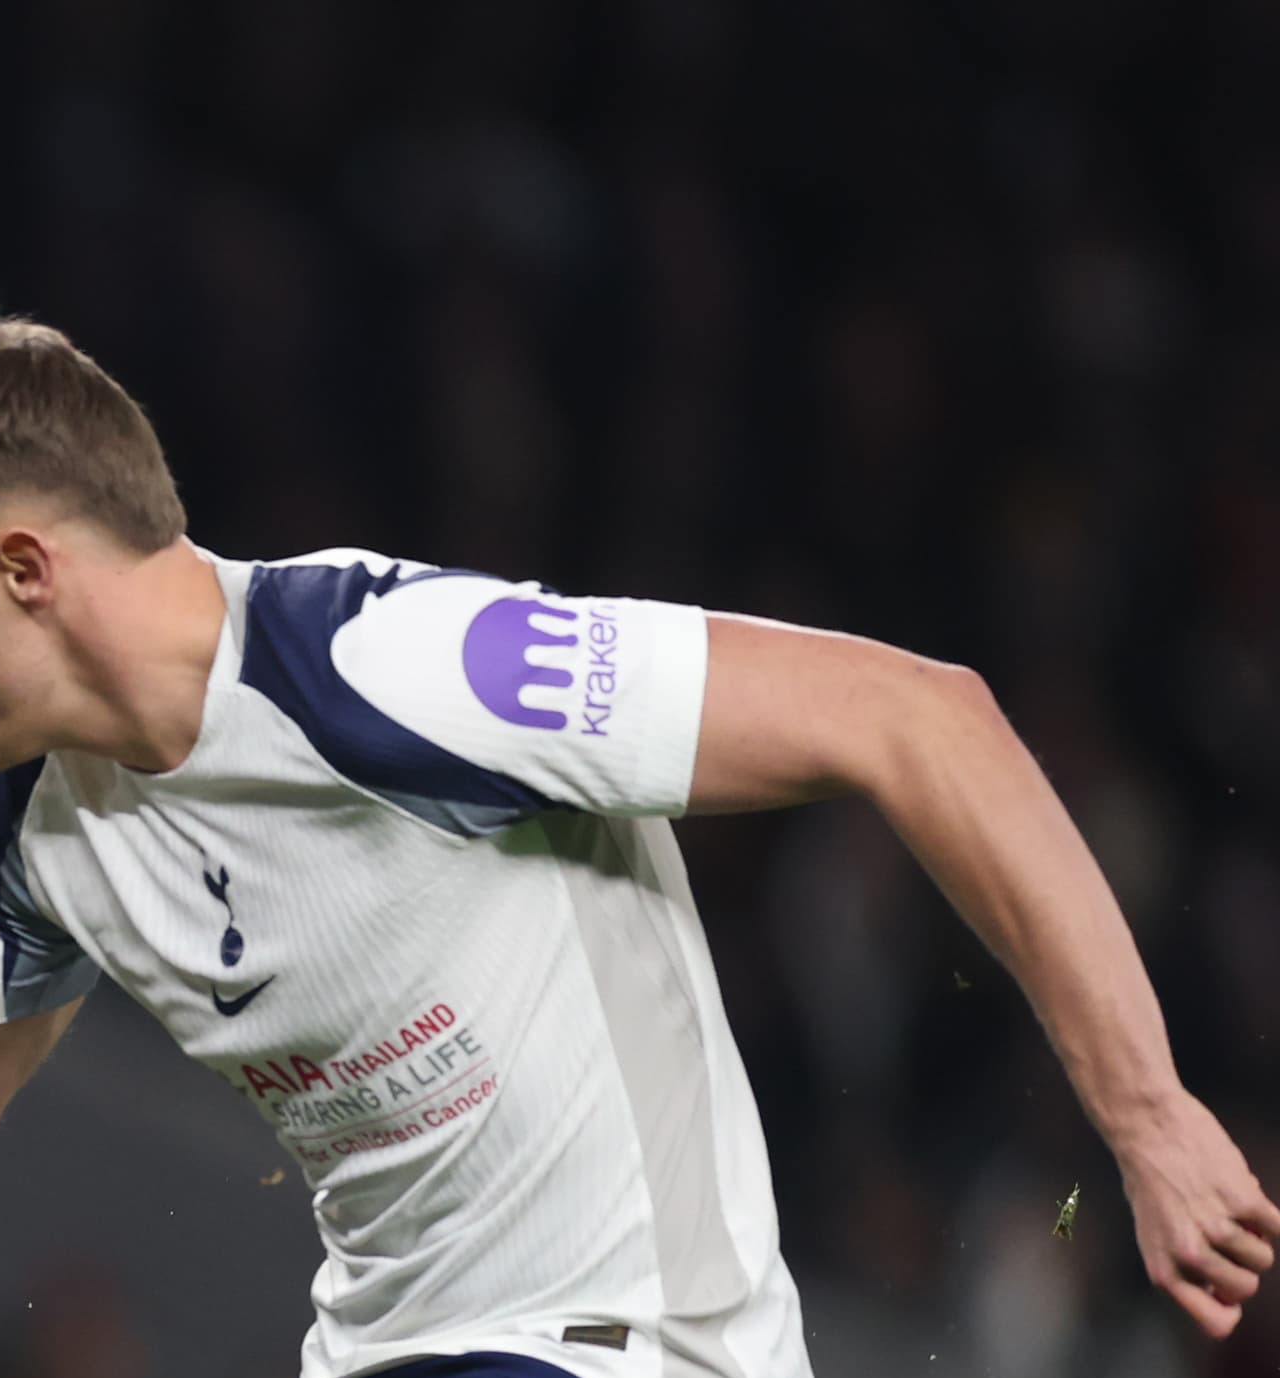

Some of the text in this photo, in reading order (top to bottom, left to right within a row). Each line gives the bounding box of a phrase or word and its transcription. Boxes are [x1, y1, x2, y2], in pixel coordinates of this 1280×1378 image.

[580, 603, 618, 737] kraken
[241, 1003, 457, 1099] AIA THAILAND
[271, 1028, 483, 1127] SHARING A LIFE
[421, 1071, 498, 1128] Cancer
